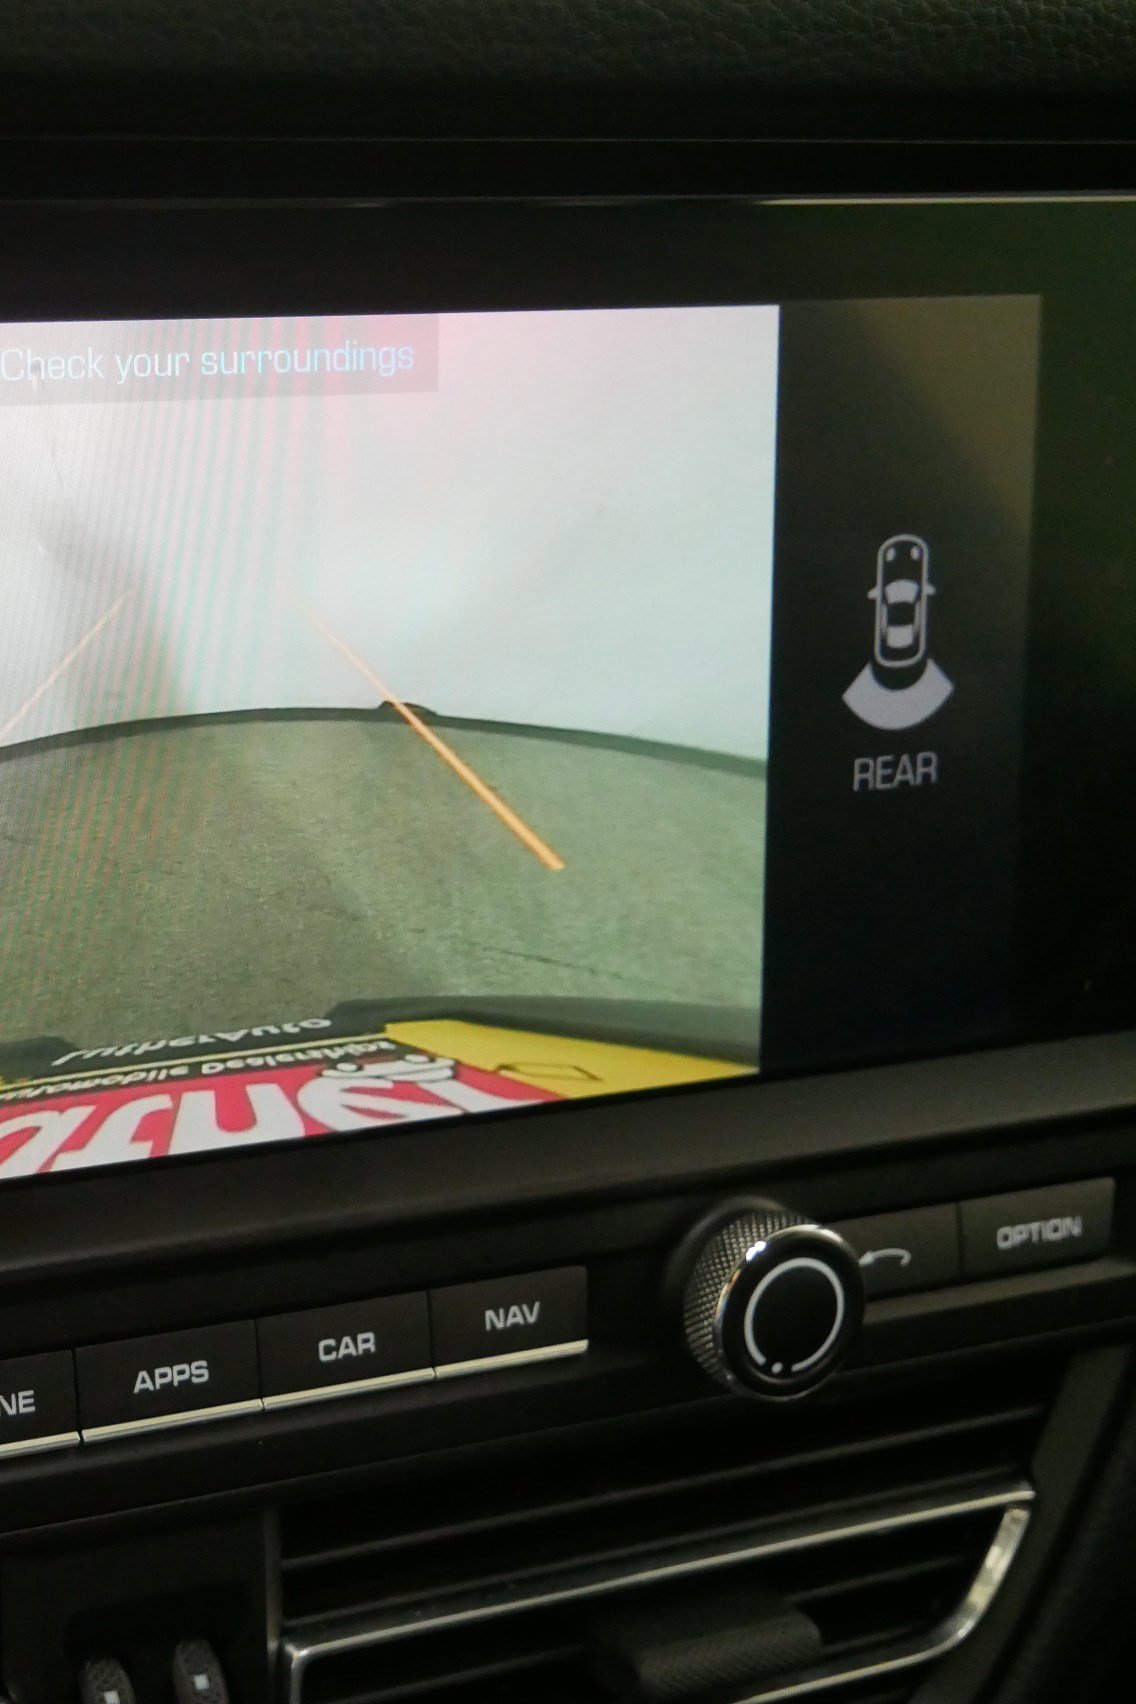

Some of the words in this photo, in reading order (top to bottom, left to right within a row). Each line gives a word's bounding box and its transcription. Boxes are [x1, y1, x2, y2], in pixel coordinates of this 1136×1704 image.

[0, 346, 103, 383] Check
[116, 349, 190, 386] your
[201, 339, 415, 378] surroundings
[852, 751, 939, 791] REAR
[996, 1216, 1082, 1250] OPTION
[484, 1302, 541, 1331] NAV
[318, 1331, 376, 1363] CAR
[133, 1360, 210, 1395] APPS
